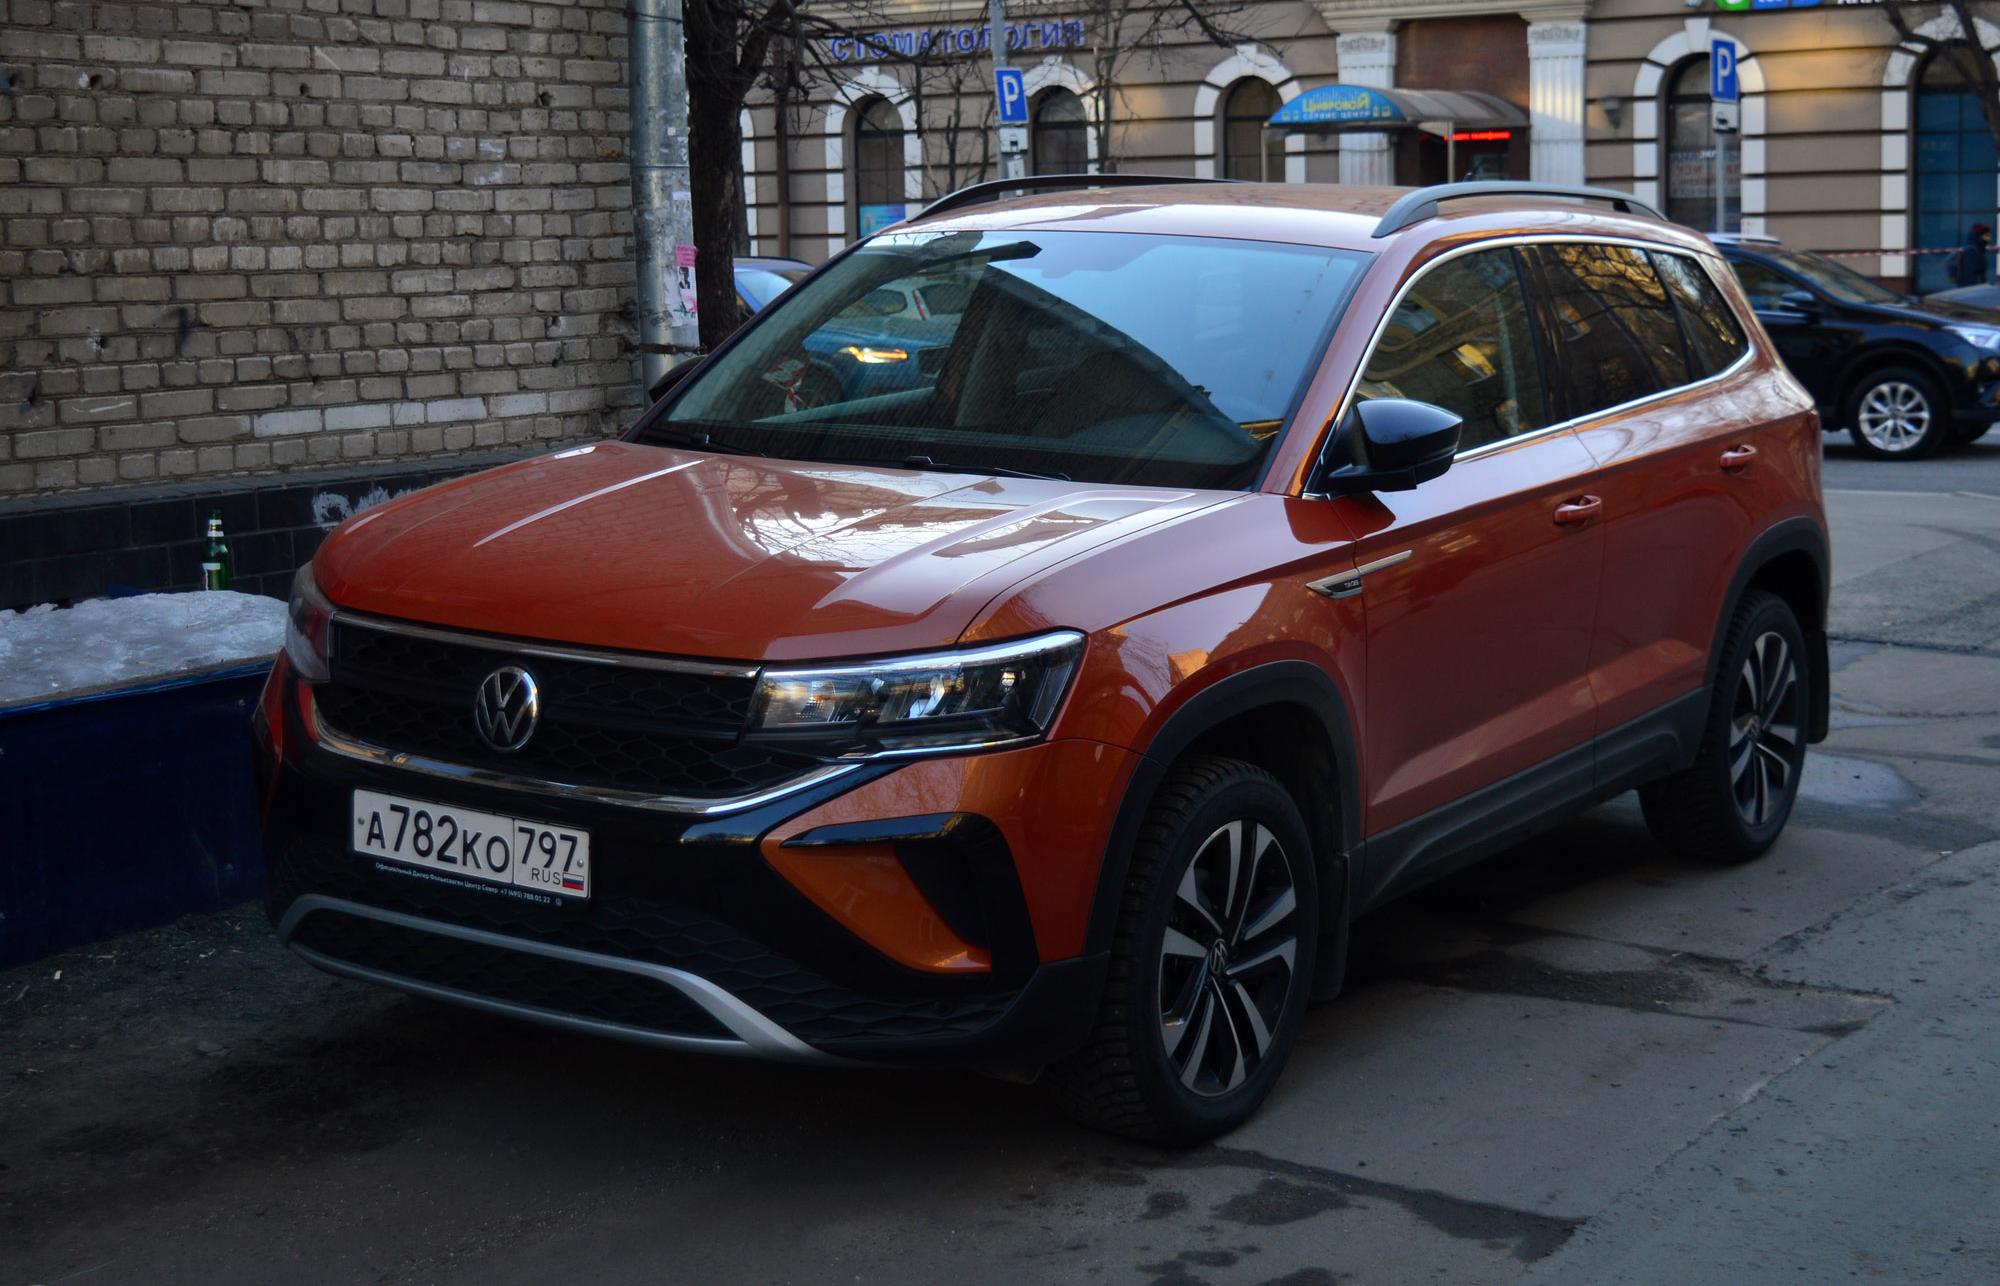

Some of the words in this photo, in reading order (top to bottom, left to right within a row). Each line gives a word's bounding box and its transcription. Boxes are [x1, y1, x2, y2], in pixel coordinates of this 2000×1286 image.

[831, 20, 1085, 61] СТОМАТОЛОГИЯ
[1718, 47, 1731, 92] P
[1002, 75, 1019, 116] P
[518, 826, 578, 873] 797
[531, 867, 561, 886] RUS
